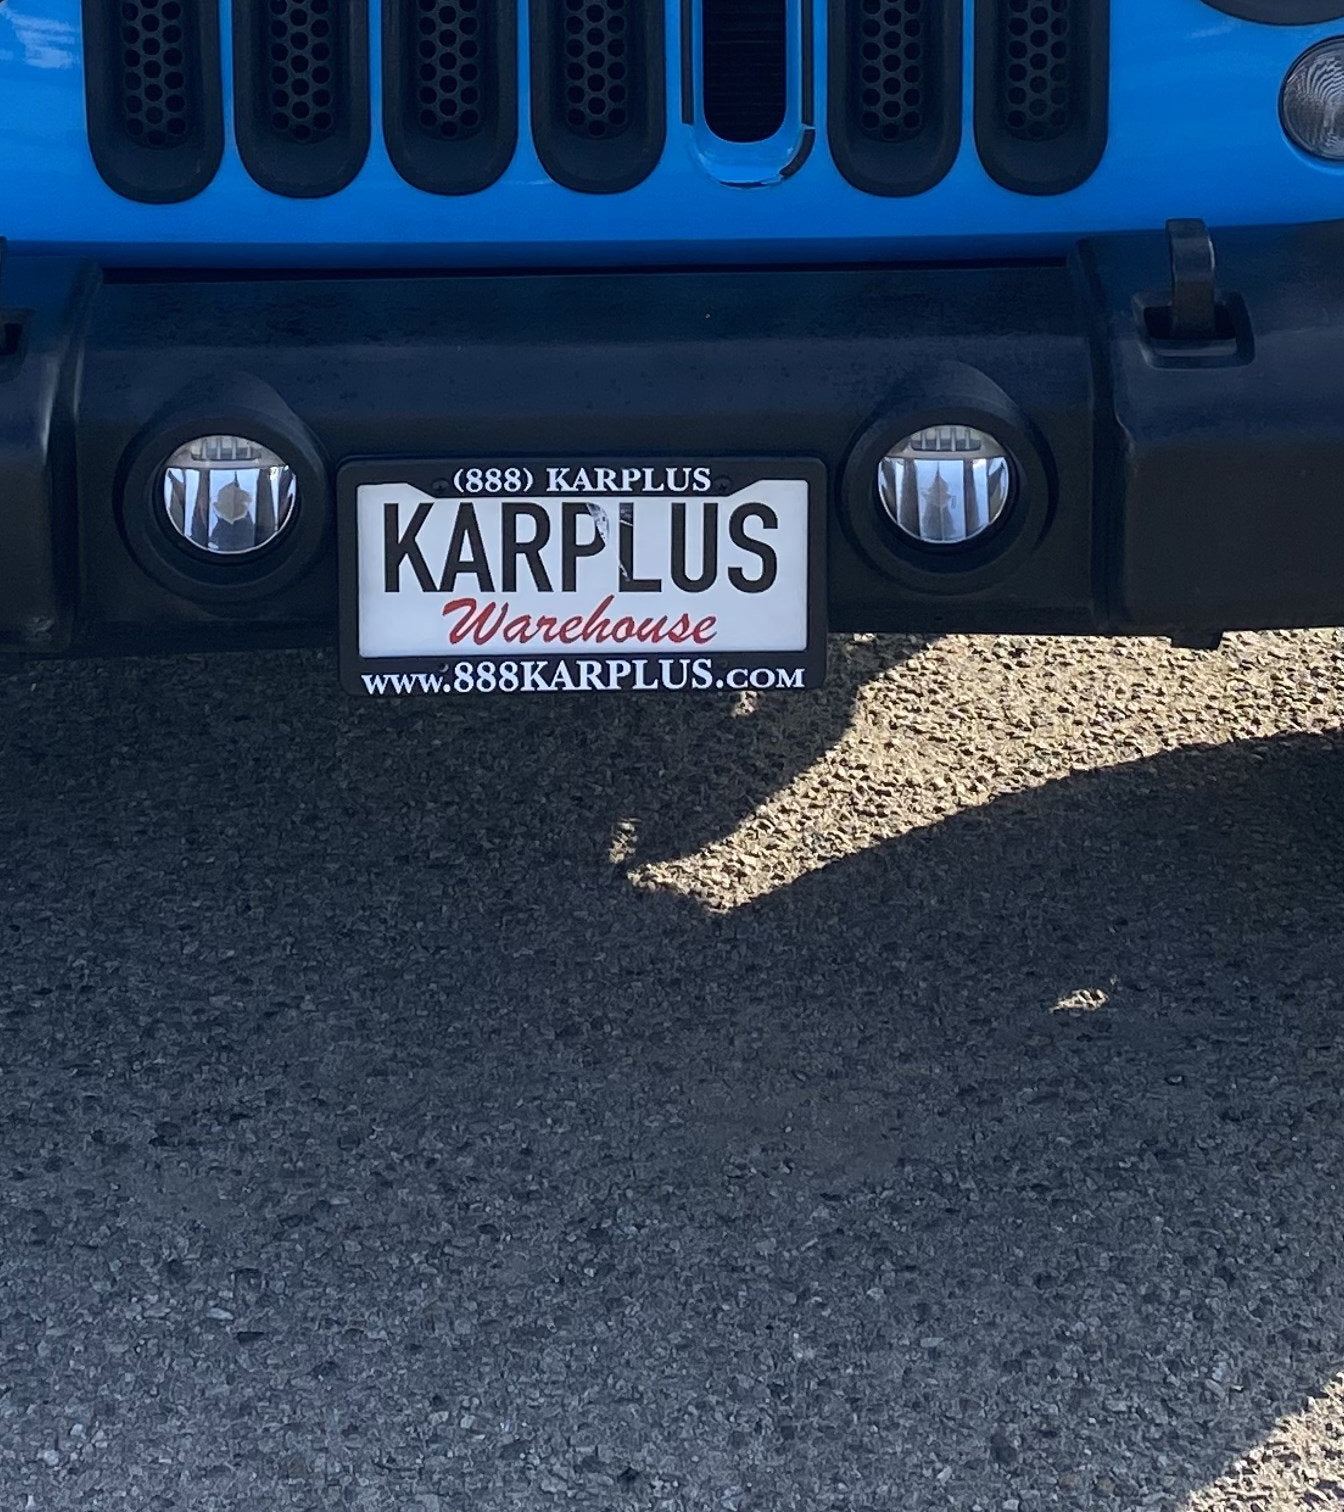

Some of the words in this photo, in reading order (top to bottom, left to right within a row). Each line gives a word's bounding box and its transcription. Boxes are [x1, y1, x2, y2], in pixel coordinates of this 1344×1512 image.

[453, 468, 534, 493] (888)
[546, 467, 712, 492] KARPLUS
[383, 501, 779, 593] KARPLUS
[442, 594, 718, 646] Warehouse
